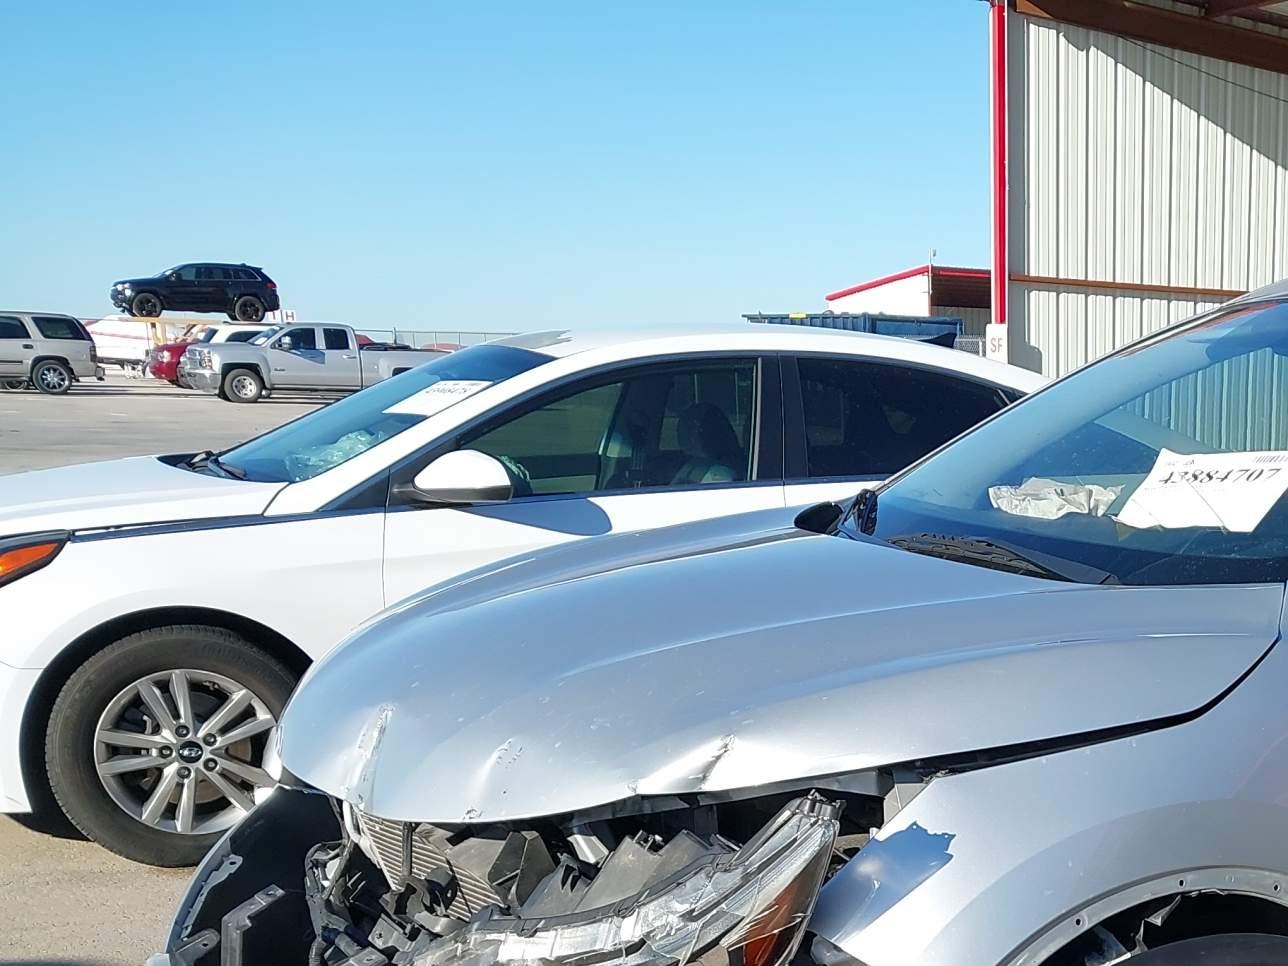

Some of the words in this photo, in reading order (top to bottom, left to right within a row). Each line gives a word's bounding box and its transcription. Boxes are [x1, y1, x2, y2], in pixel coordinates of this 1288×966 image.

[285, 311, 295, 321] H
[990, 336, 1004, 353] SF
[1158, 467, 1283, 485] 43884707
